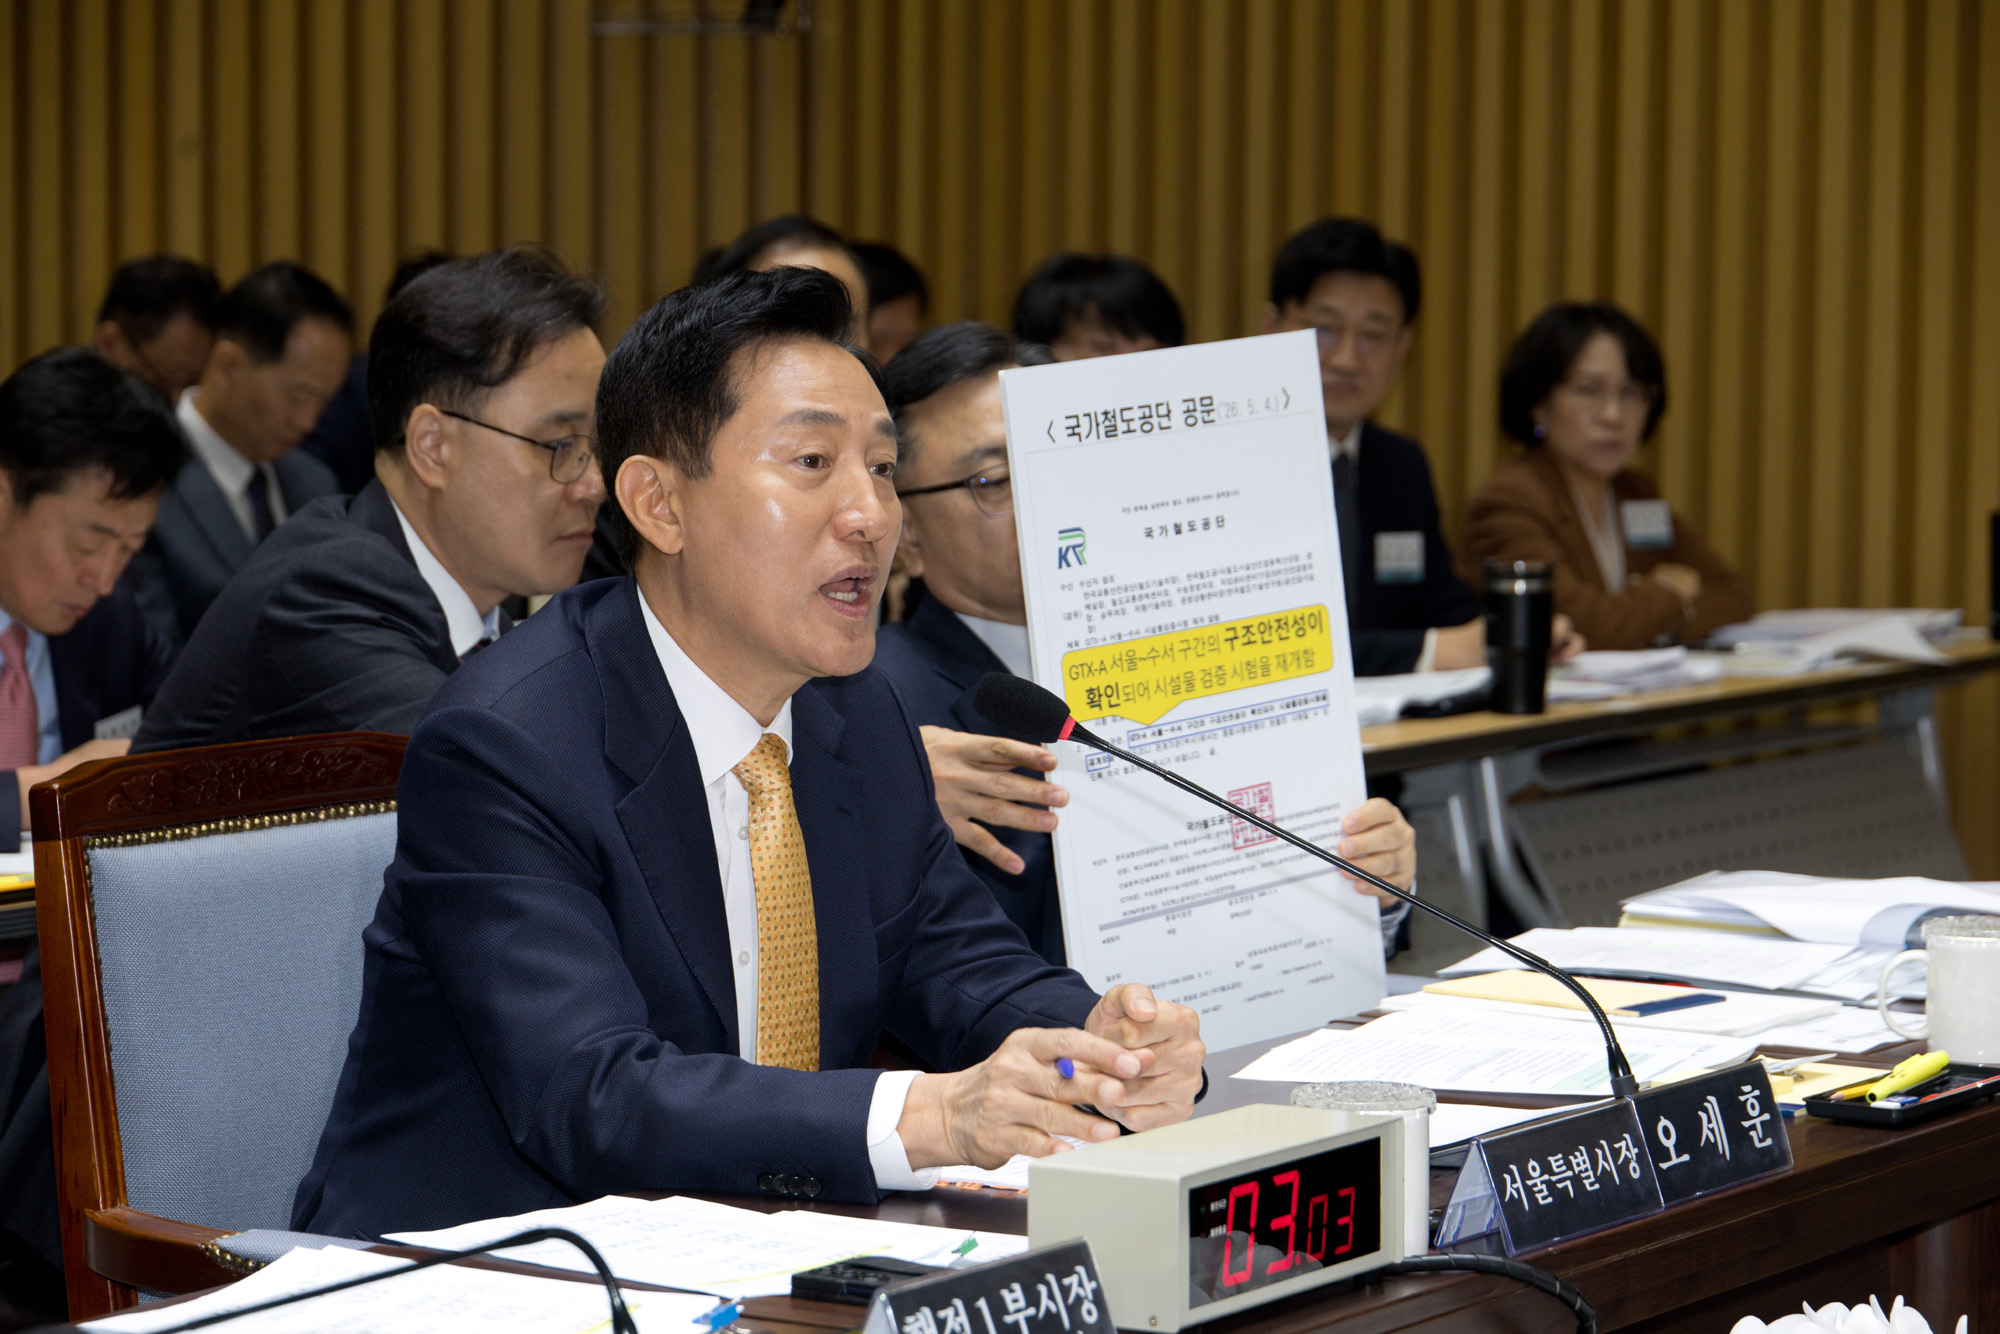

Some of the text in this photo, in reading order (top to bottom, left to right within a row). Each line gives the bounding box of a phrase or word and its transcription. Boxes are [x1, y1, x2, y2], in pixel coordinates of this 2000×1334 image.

[1065, 400, 1172, 443] 국가철도공단
[1069, 609, 1324, 681] GTX-A 서울~수서 구간의 구조안전성이
[1085, 647, 1315, 711] 확인되어 시설물 검증 시험을 재개함
[1503, 1133, 1641, 1212] 서울특별시장
